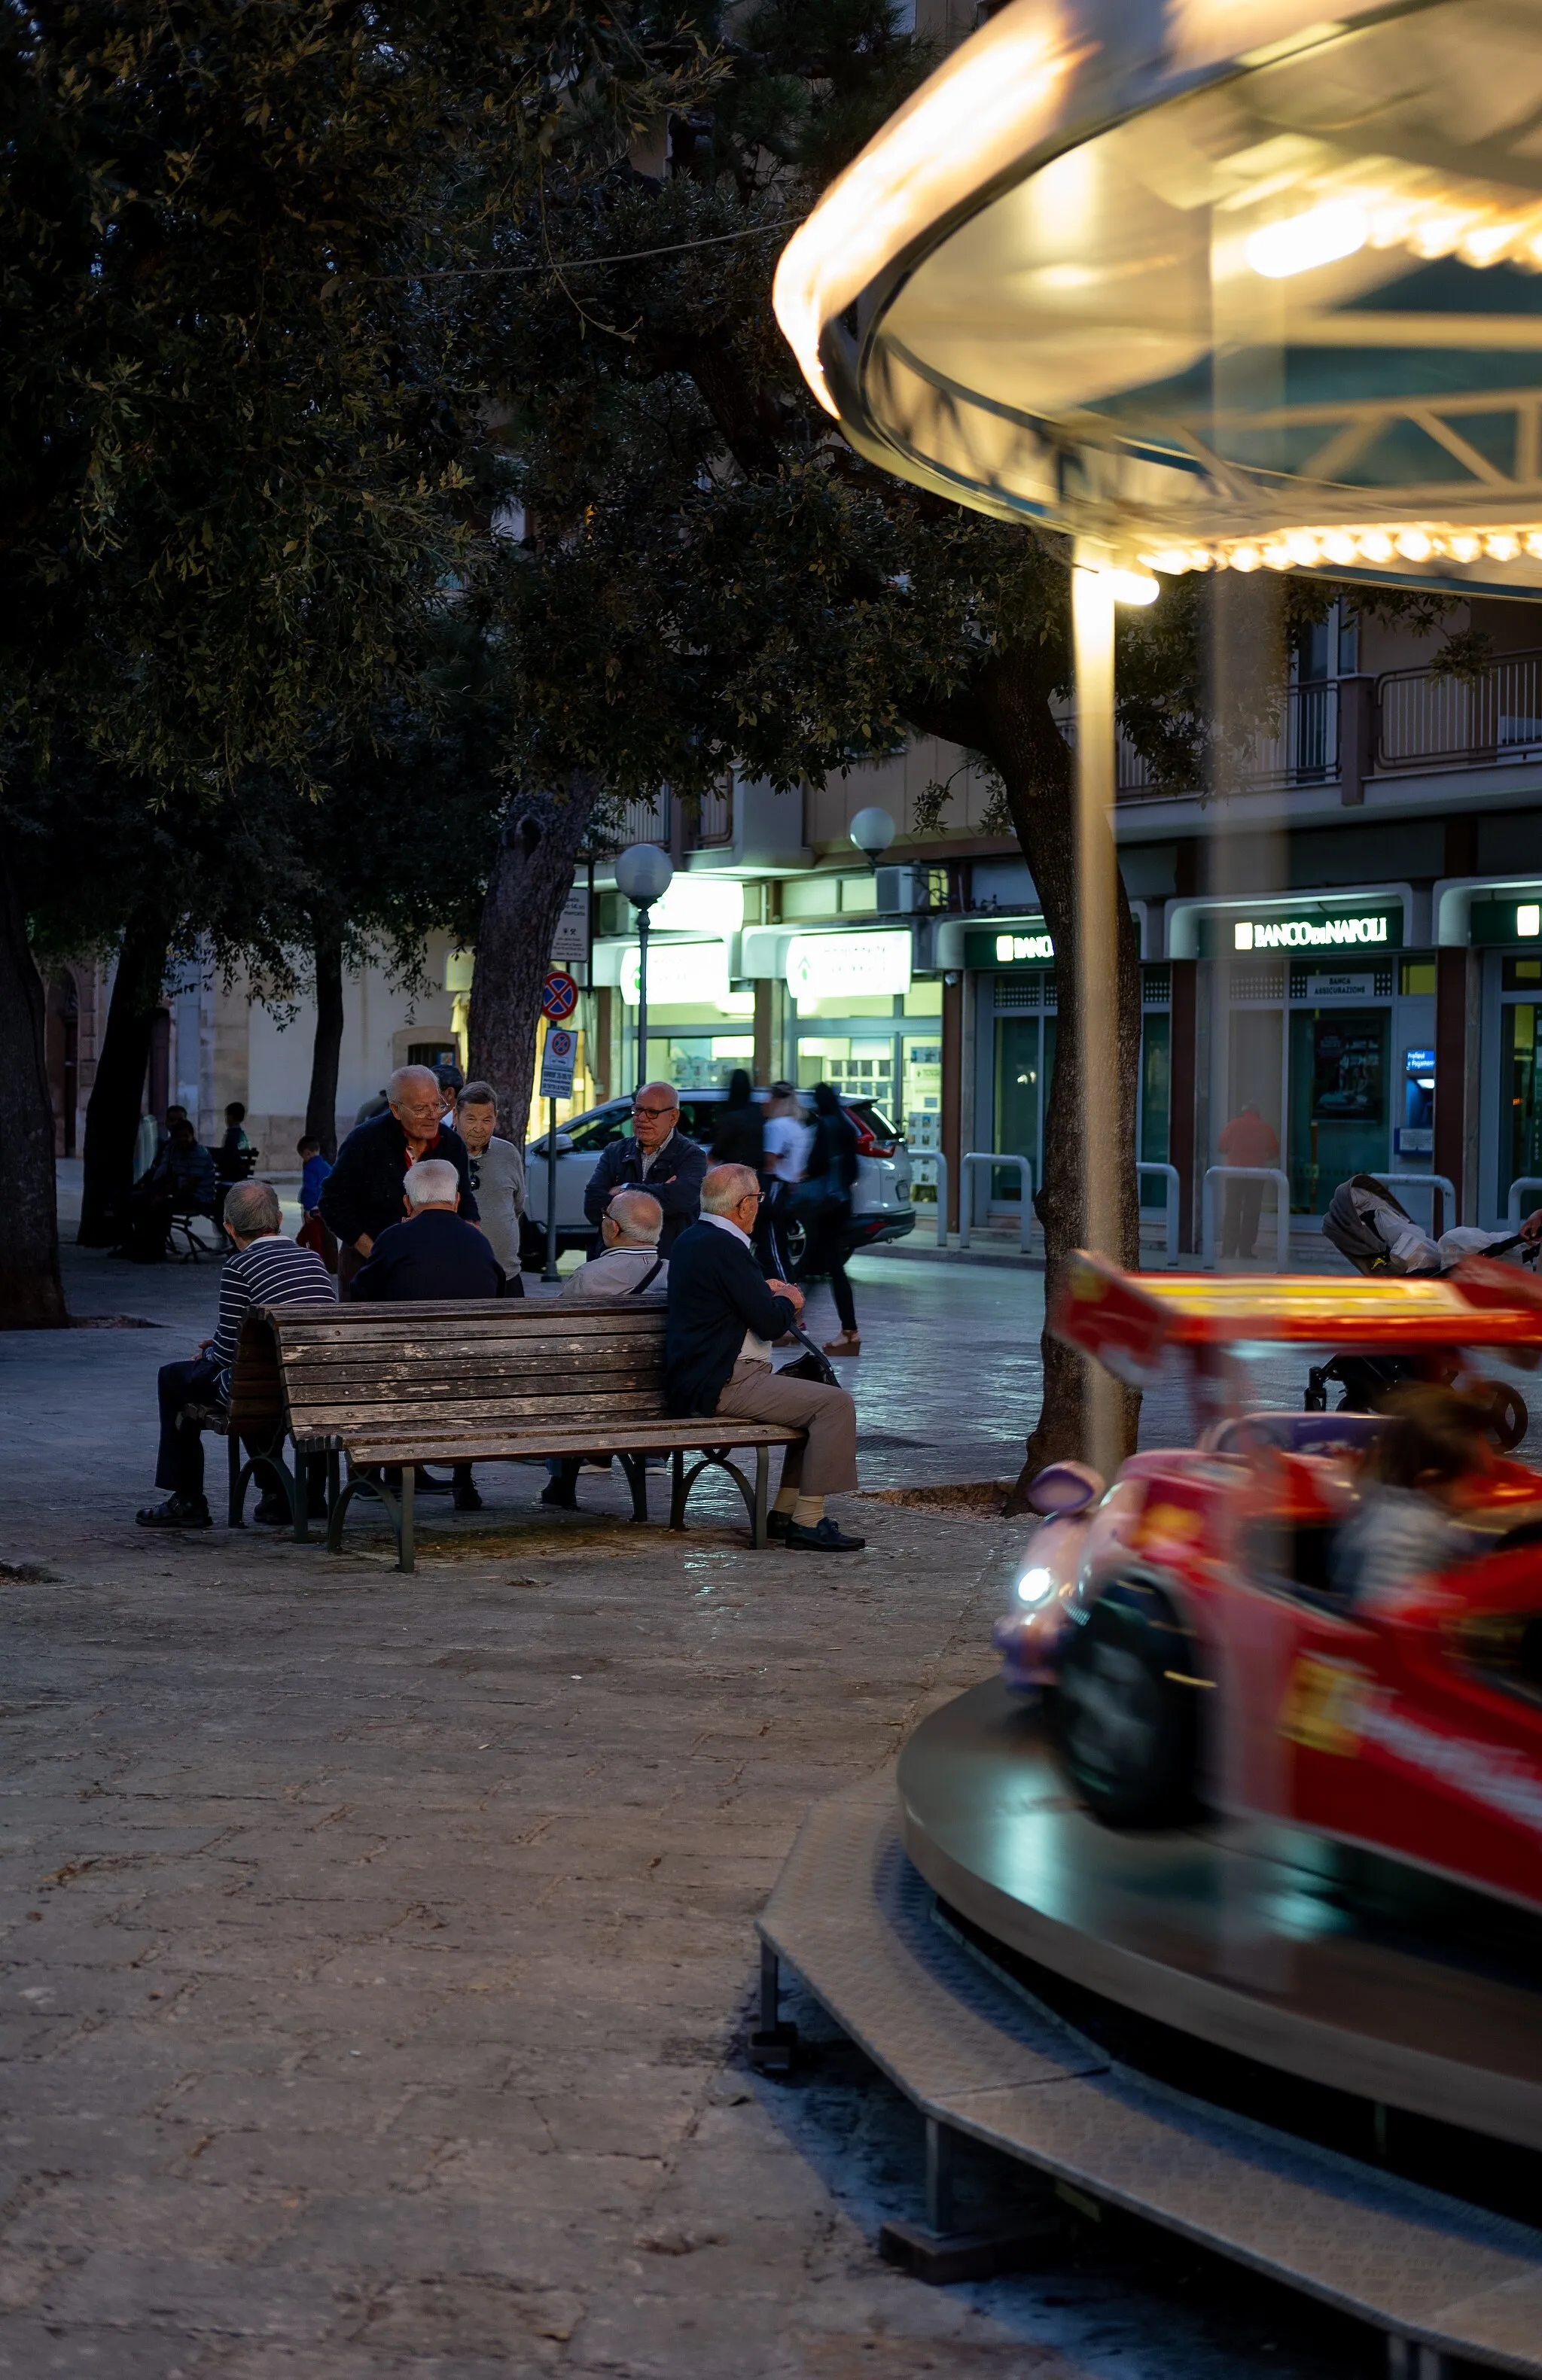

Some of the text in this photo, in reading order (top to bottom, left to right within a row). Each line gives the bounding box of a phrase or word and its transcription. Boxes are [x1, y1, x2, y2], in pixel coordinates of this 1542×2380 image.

[1254, 922, 1312, 947] BANCO
[1325, 918, 1388, 944] NAPOLI
[1013, 936, 1054, 958] BANC
